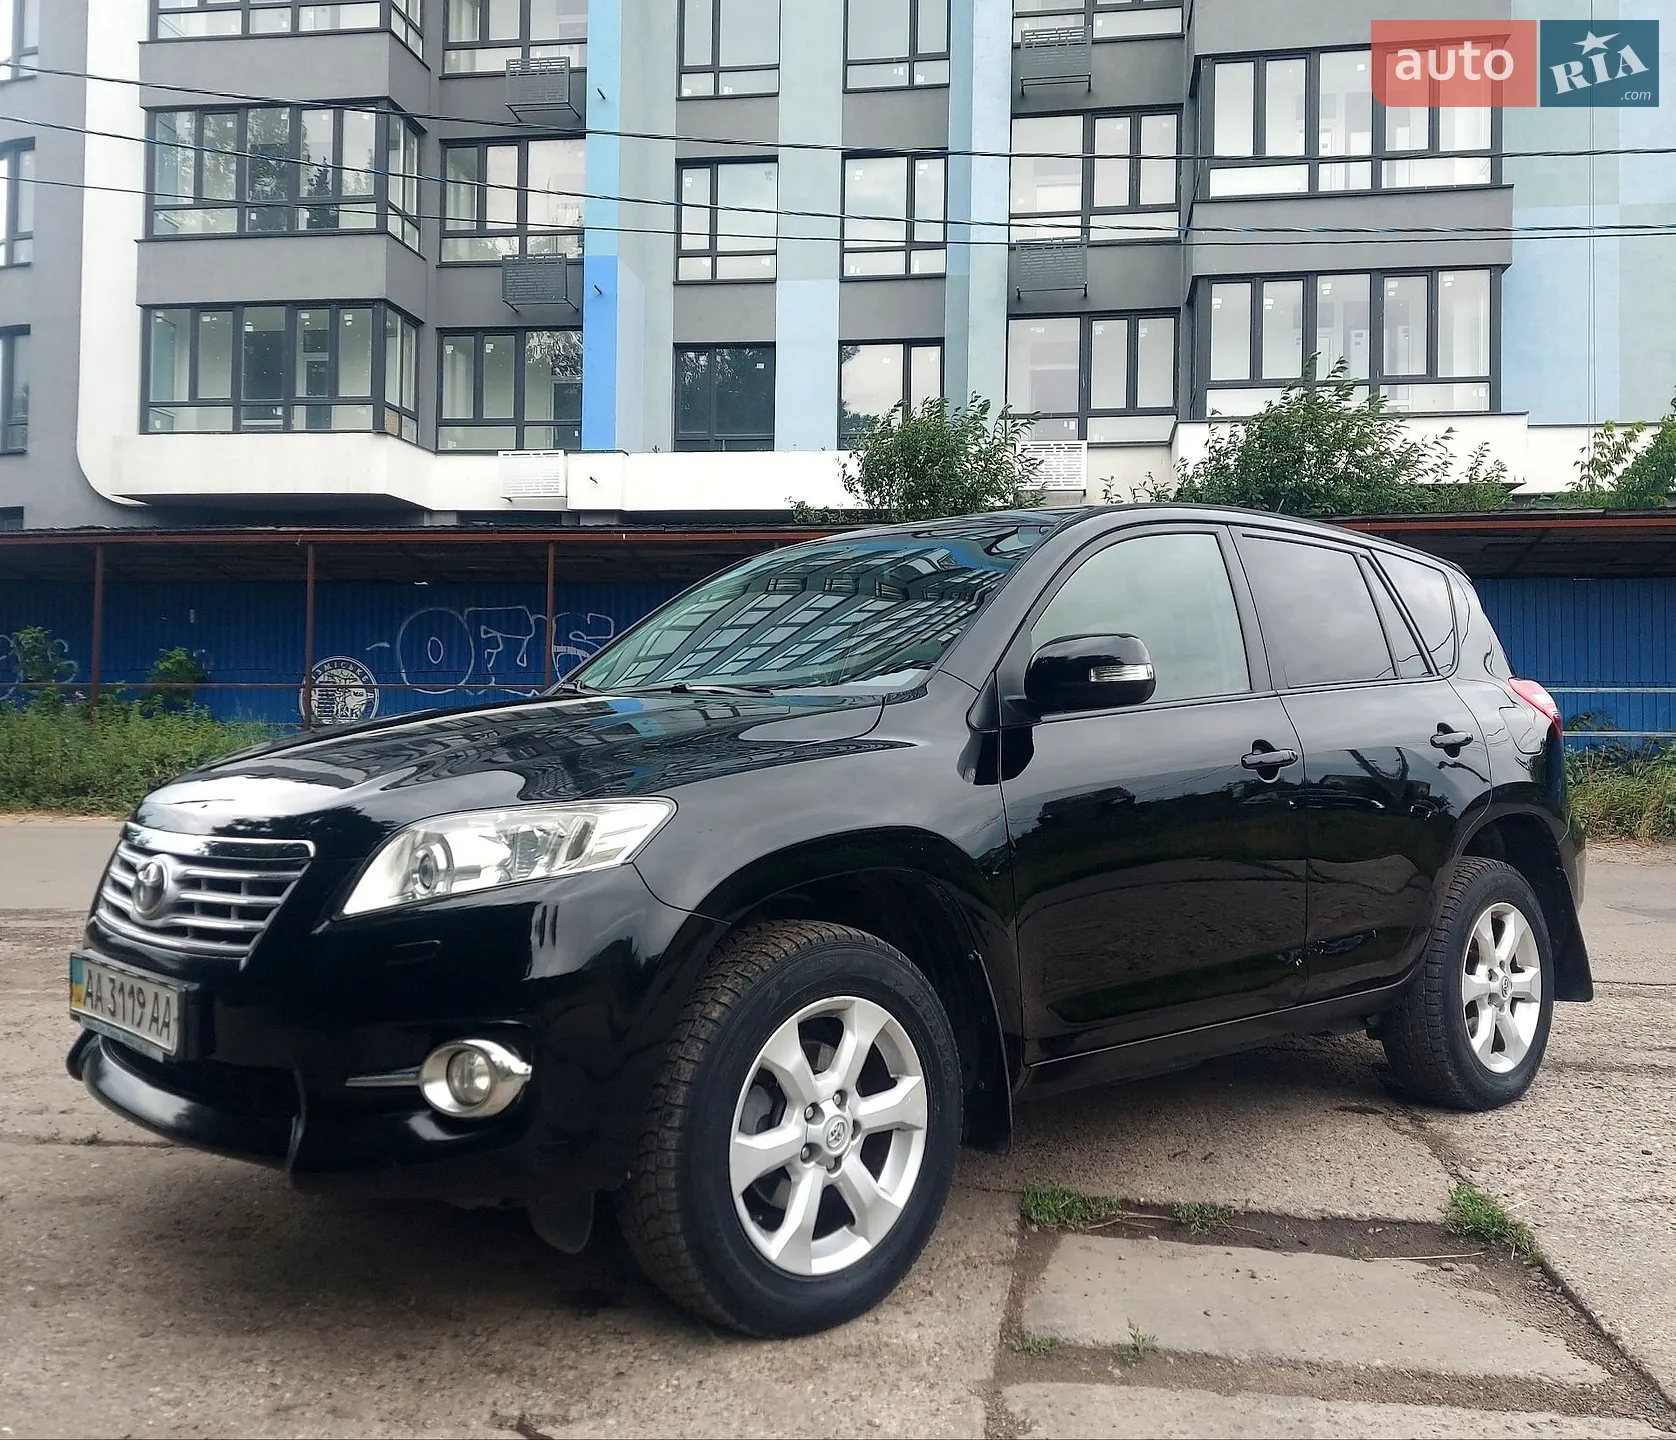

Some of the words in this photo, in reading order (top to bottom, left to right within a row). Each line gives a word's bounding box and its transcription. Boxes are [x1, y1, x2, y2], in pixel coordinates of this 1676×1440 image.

[83, 968, 104, 1012] AA
[107, 976, 146, 1028] 3119
[148, 991, 171, 1041] AA
